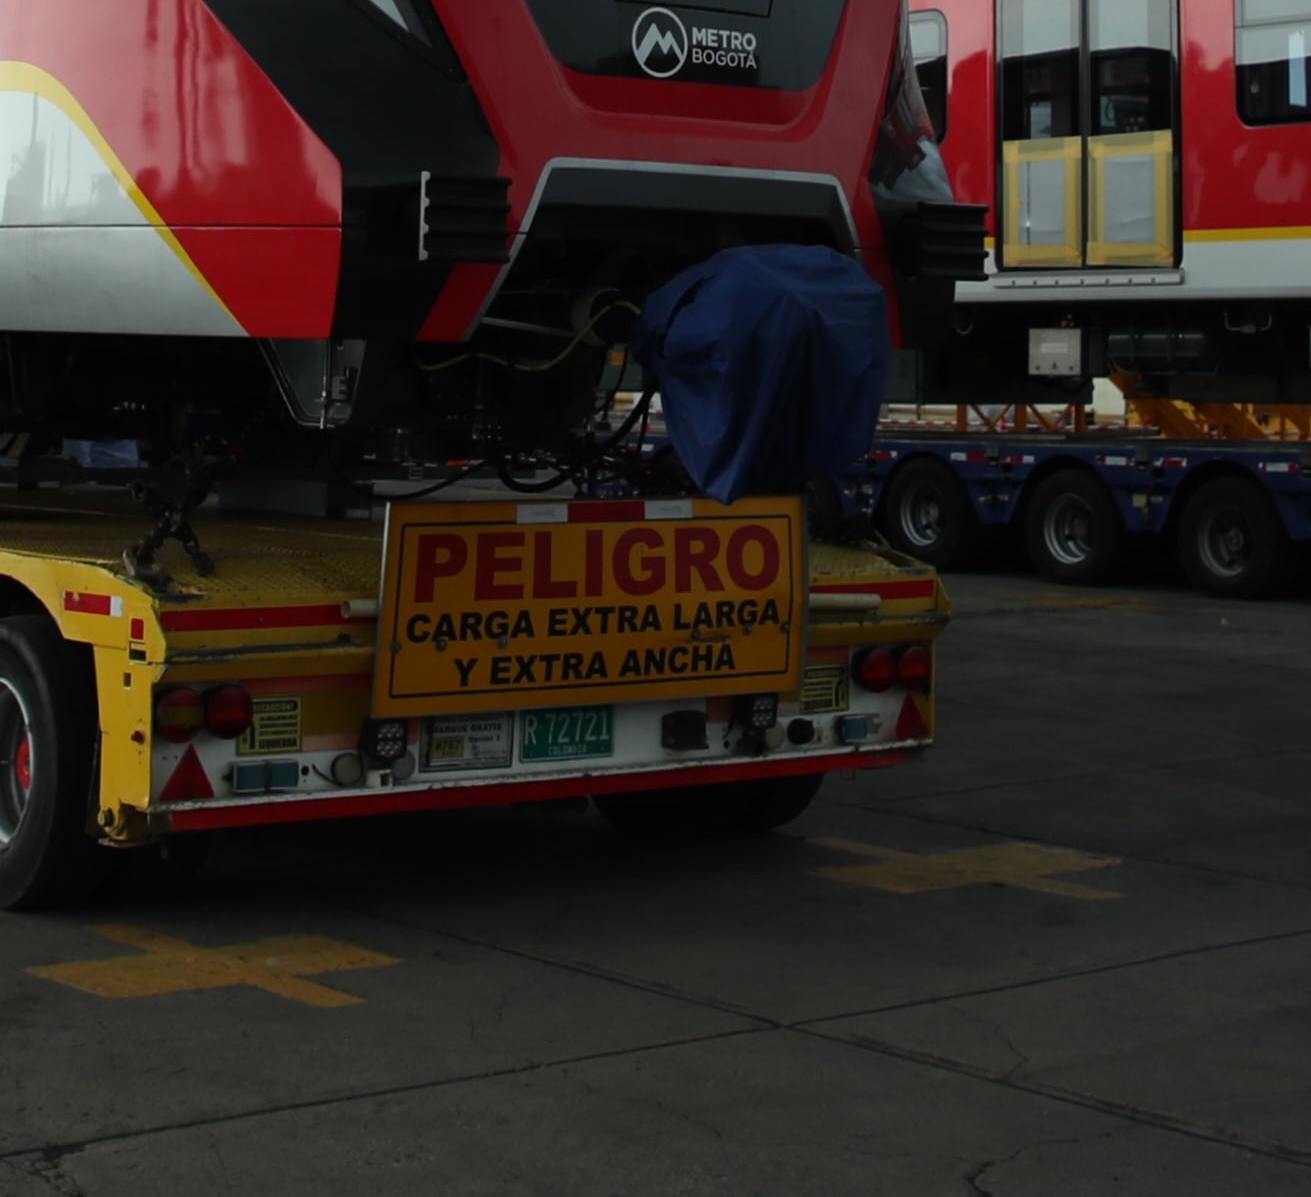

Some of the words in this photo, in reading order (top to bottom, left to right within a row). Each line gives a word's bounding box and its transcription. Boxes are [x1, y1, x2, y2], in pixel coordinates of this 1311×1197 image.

[691, 26, 757, 52] METRO
[691, 47, 758, 70] BOGOTÁ
[413, 524, 780, 604] PELIGRO
[406, 609, 535, 643] CARGA
[547, 605, 662, 637] EXTRA
[673, 598, 780, 632] LARGA
[453, 657, 479, 687] Y
[489, 651, 608, 684] EXTRA
[618, 642, 736, 678] ANCHA
[524, 713, 538, 746] R
[544, 709, 611, 744] 72721
